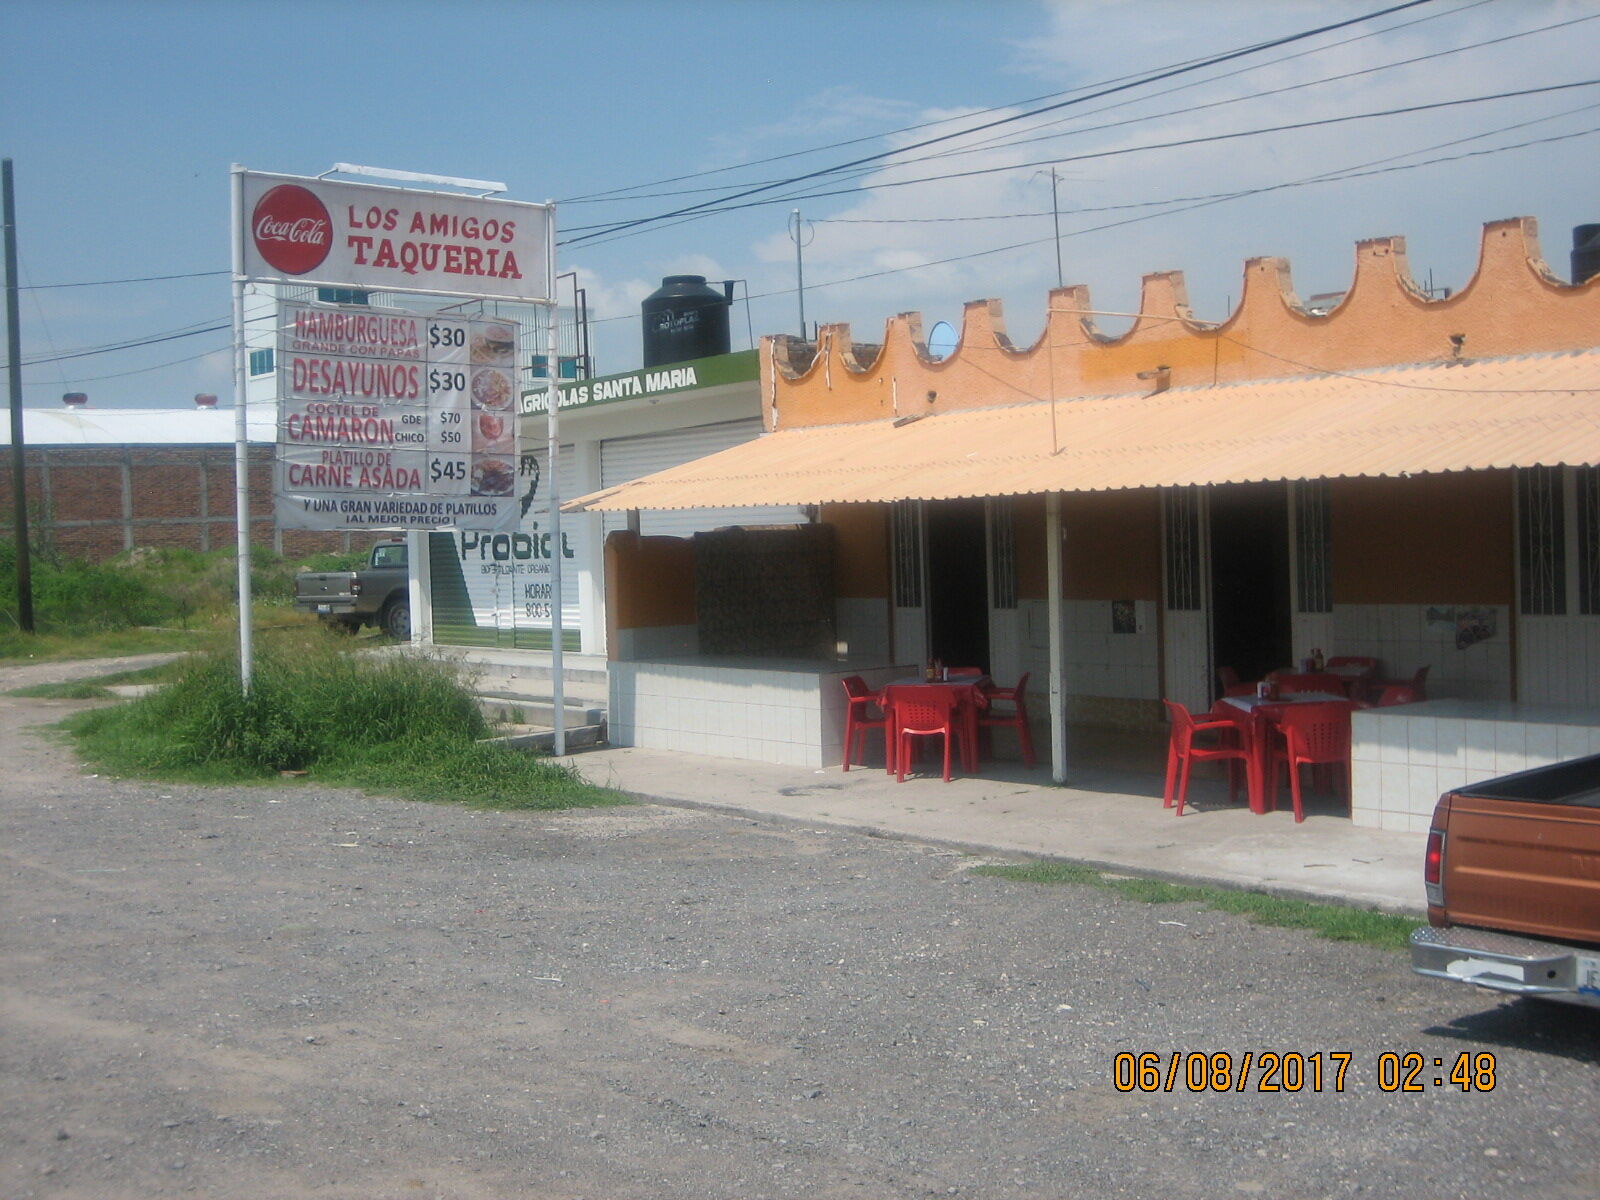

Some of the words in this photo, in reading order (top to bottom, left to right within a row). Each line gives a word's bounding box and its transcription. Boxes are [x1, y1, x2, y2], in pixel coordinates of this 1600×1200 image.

[256, 215, 326, 244] Coca-Cola
[348, 205, 399, 231] LOS
[409, 211, 517, 244] AMIGOS
[347, 235, 523, 280] TAQUERIA
[294, 310, 418, 347] HAMBURGUESA
[430, 323, 465, 348] $30
[292, 340, 346, 354] GRANDE
[350, 344, 377, 355] CON
[380, 346, 420, 359] PAPAS
[293, 357, 419, 400] DESAYUNOS
[430, 369, 466, 394] $30
[593, 375, 643, 400] SANTA
[645, 366, 697, 392] MARIA
[306, 403, 358, 416] COCTEL
[362, 406, 379, 417] DE
[401, 415, 422, 425] GDE
[440, 411, 461, 425] $70
[288, 413, 394, 444] CAMARON
[394, 432, 425, 443] CHICO
[440, 431, 461, 444] $50
[322, 450, 374, 466] PLATILLO
[377, 452, 392, 466] DE
[430, 458, 466, 483] $45
[289, 464, 353, 487] CARNE
[358, 467, 422, 490] ASADA
[304, 498, 311, 512] Y
[314, 499, 338, 513] UNA
[341, 500, 371, 513] GRAN
[374, 501, 427, 514] VARIEDAD
[430, 502, 443, 515] DE
[446, 503, 497, 516] PLATILLOS
[368, 515, 407, 524] MEJOR
[410, 516, 450, 524] PRECIO
